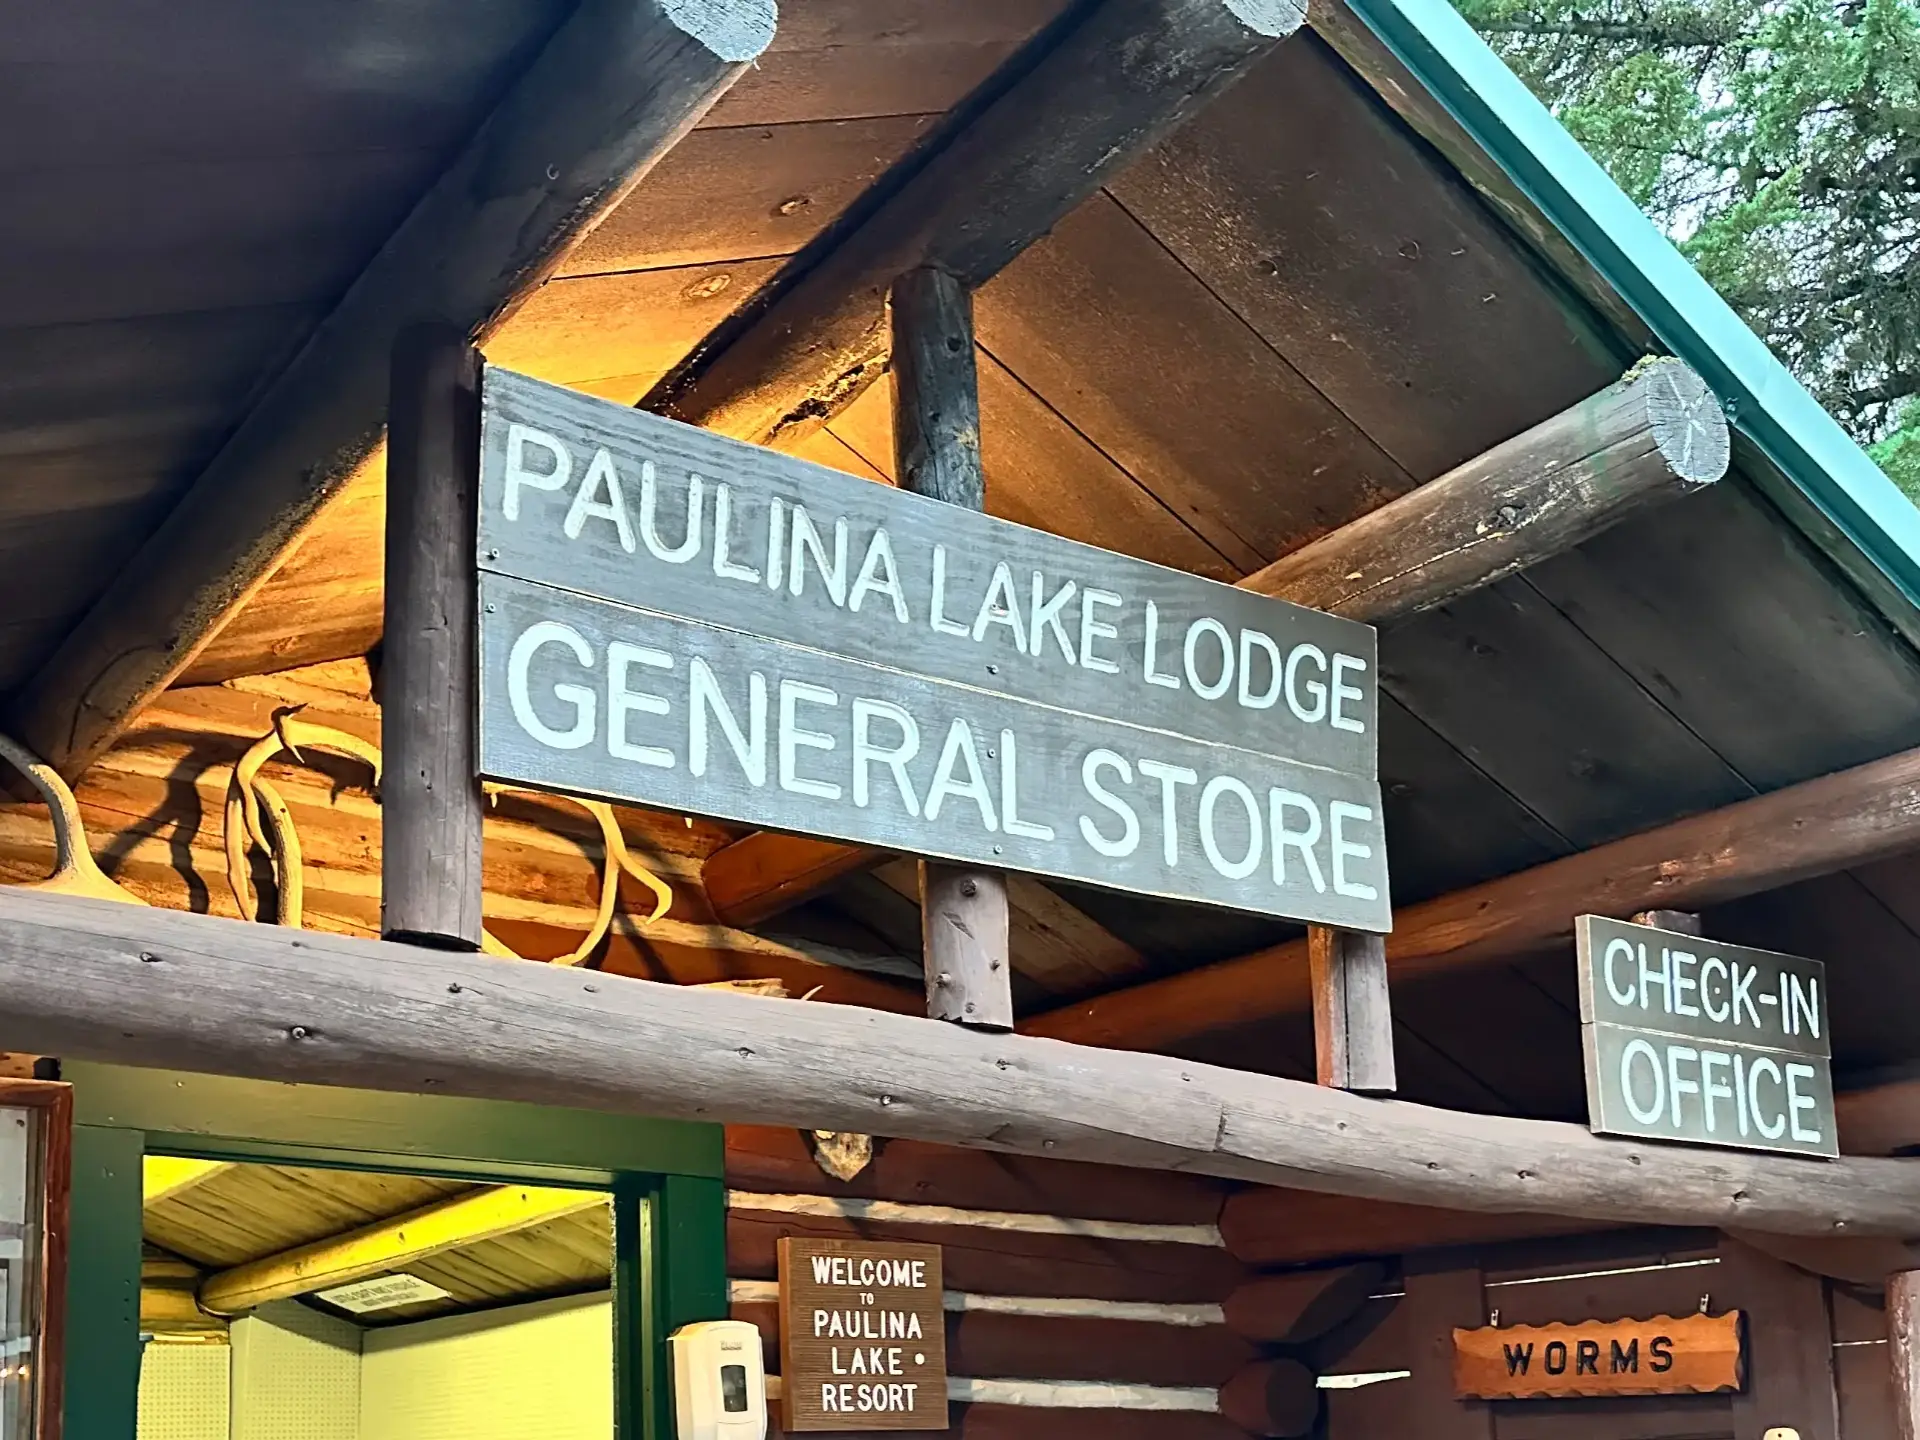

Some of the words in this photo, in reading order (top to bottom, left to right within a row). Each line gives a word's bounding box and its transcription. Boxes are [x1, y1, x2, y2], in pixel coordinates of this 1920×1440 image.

[503, 424, 909, 623] PAULINA
[930, 544, 1122, 674] LAKE
[1144, 600, 1366, 733] LODGE
[507, 621, 1054, 840] GENERAL
[1079, 748, 1377, 900] STORE
[1604, 938, 1820, 1039] CHECK-IN
[1621, 1039, 1821, 1143] OFFICE
[811, 1256, 926, 1288] WELCOME
[859, 1292, 874, 1305] TO
[814, 1310, 922, 1339] PAULINA
[831, 1347, 904, 1375] LAKE
[1503, 1336, 1675, 1376] WORMS
[822, 1384, 918, 1412] RESORT
